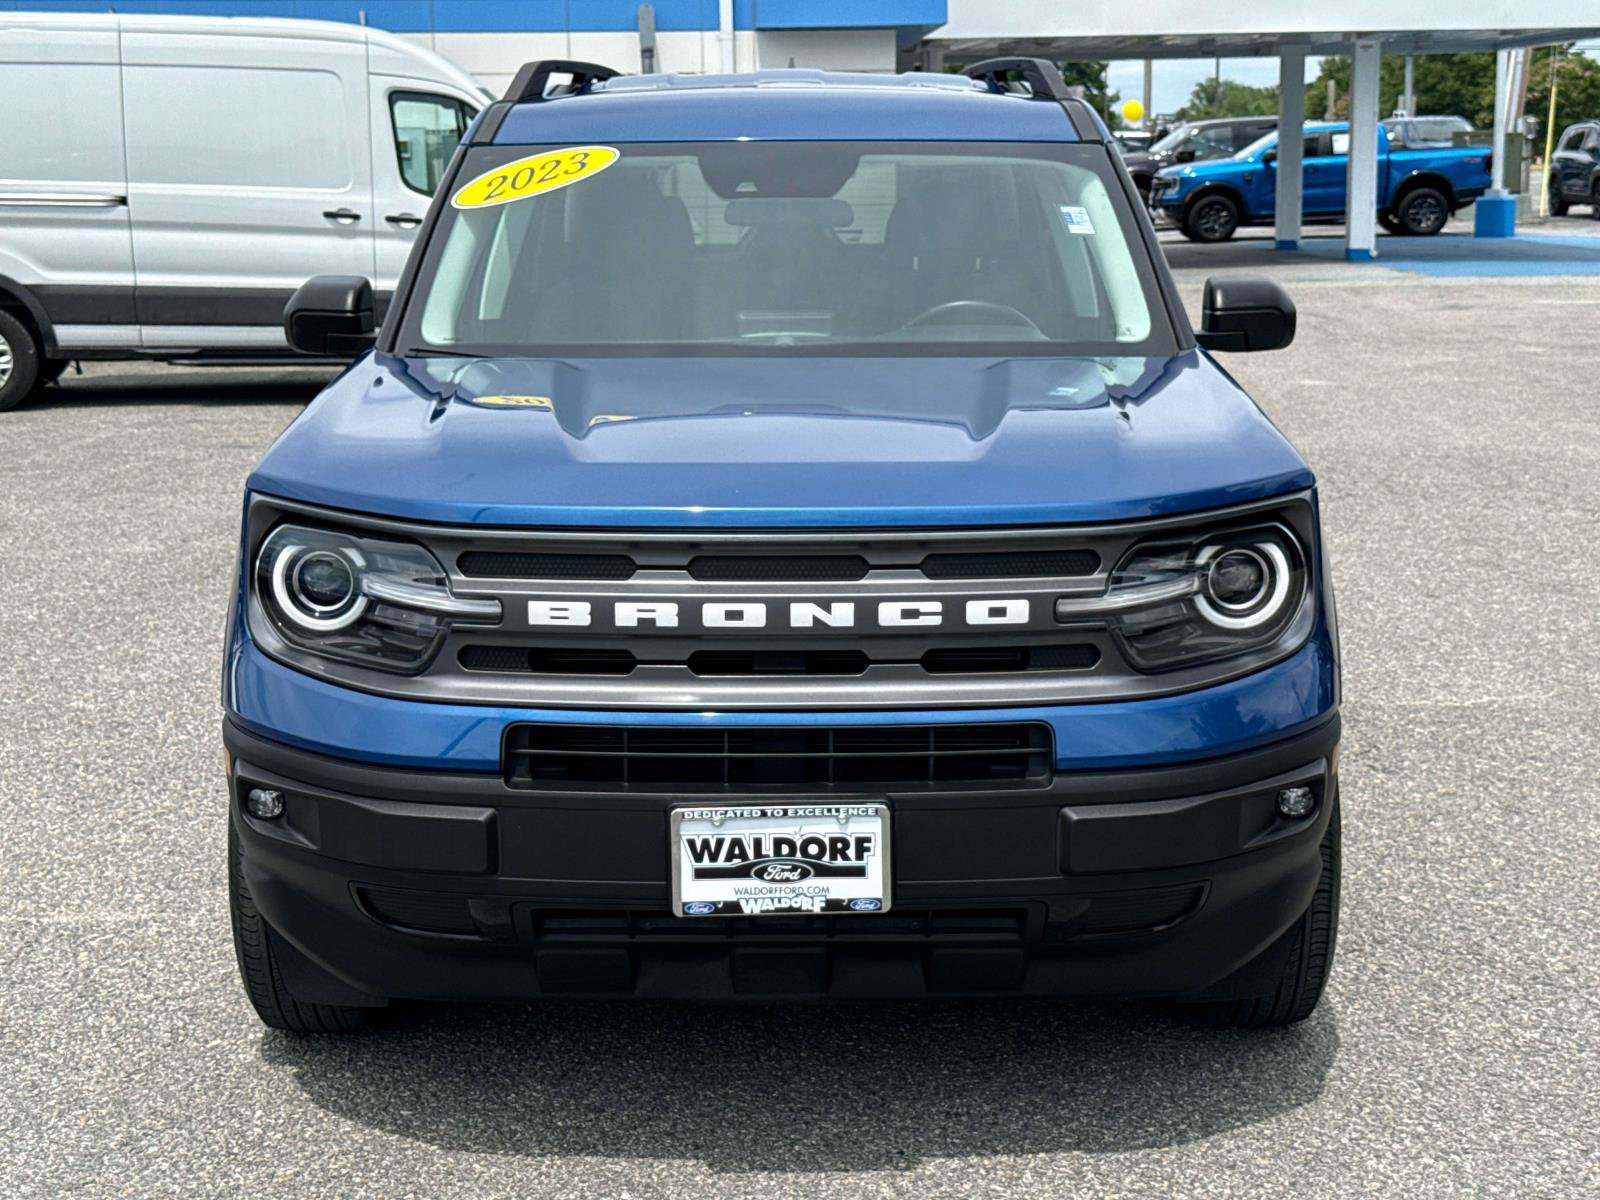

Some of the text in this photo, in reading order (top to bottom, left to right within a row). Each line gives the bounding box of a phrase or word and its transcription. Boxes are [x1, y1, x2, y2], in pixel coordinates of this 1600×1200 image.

[483, 152, 590, 201] 2023
[527, 599, 1029, 627] BRONCO
[684, 807, 876, 819] DEDICATED TO EXCELLENCE
[686, 836, 872, 863] WALDORF
[763, 864, 801, 881] Ford
[689, 902, 710, 912] Ford
[738, 895, 826, 913] WALDORF
[855, 899, 876, 909] Ford
